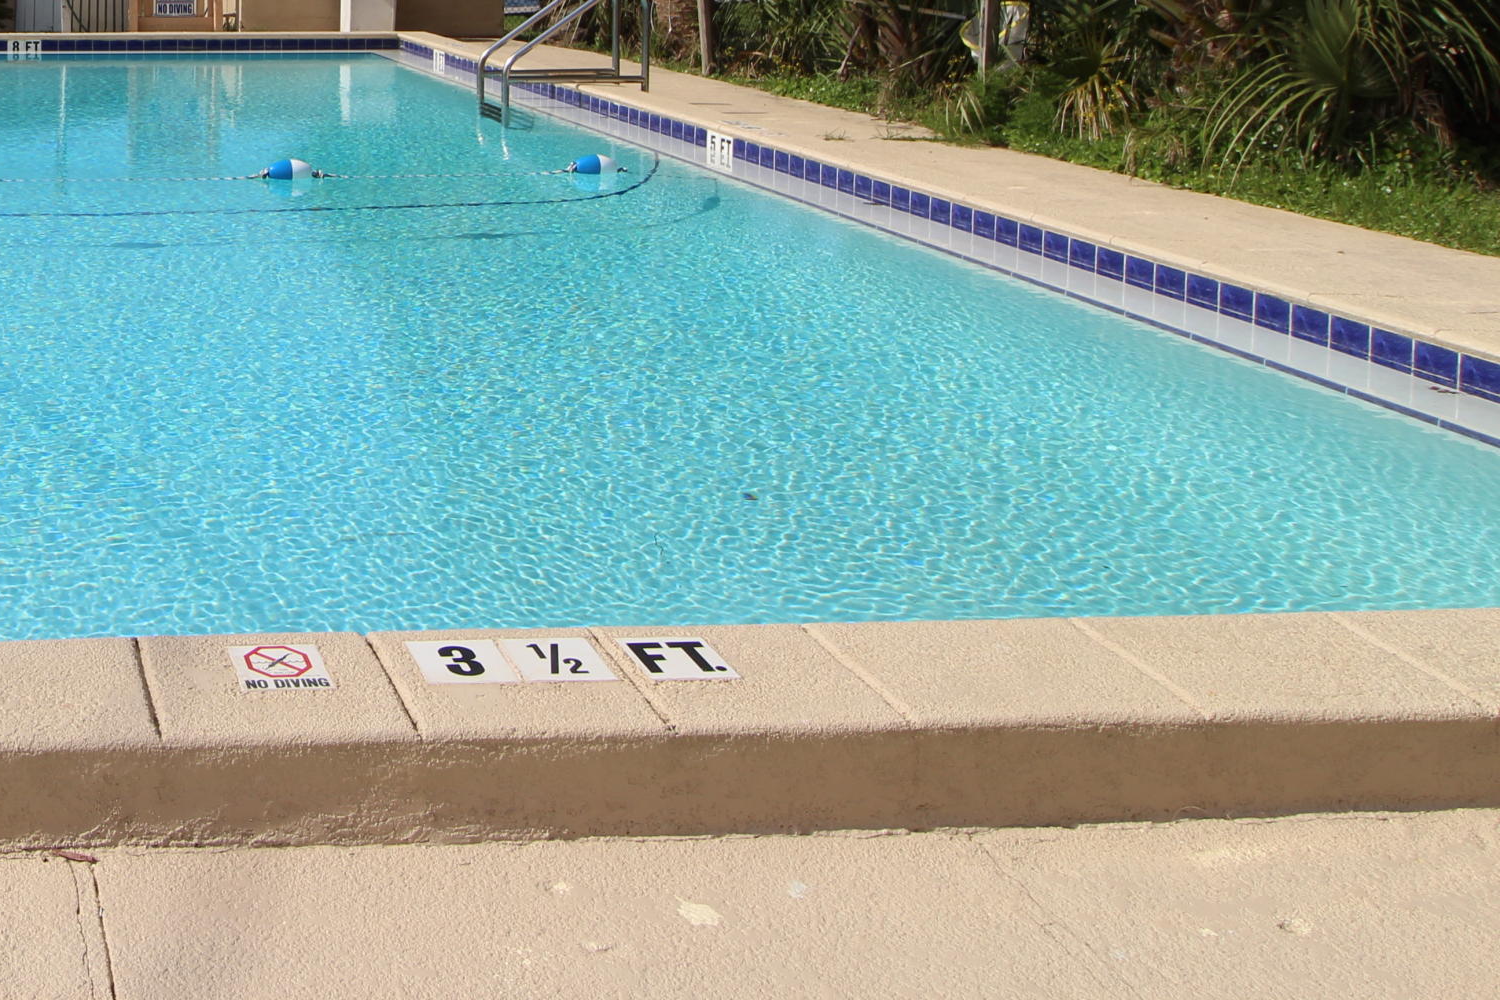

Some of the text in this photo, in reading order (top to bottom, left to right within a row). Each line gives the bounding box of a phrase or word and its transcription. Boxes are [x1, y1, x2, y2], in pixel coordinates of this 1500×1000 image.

[158, 3, 193, 14] NO DIVING
[12, 41, 40, 52] 8 FT
[437, 645, 486, 676] 3
[626, 641, 728, 673] FT.
[245, 677, 331, 689] NO DIVING
